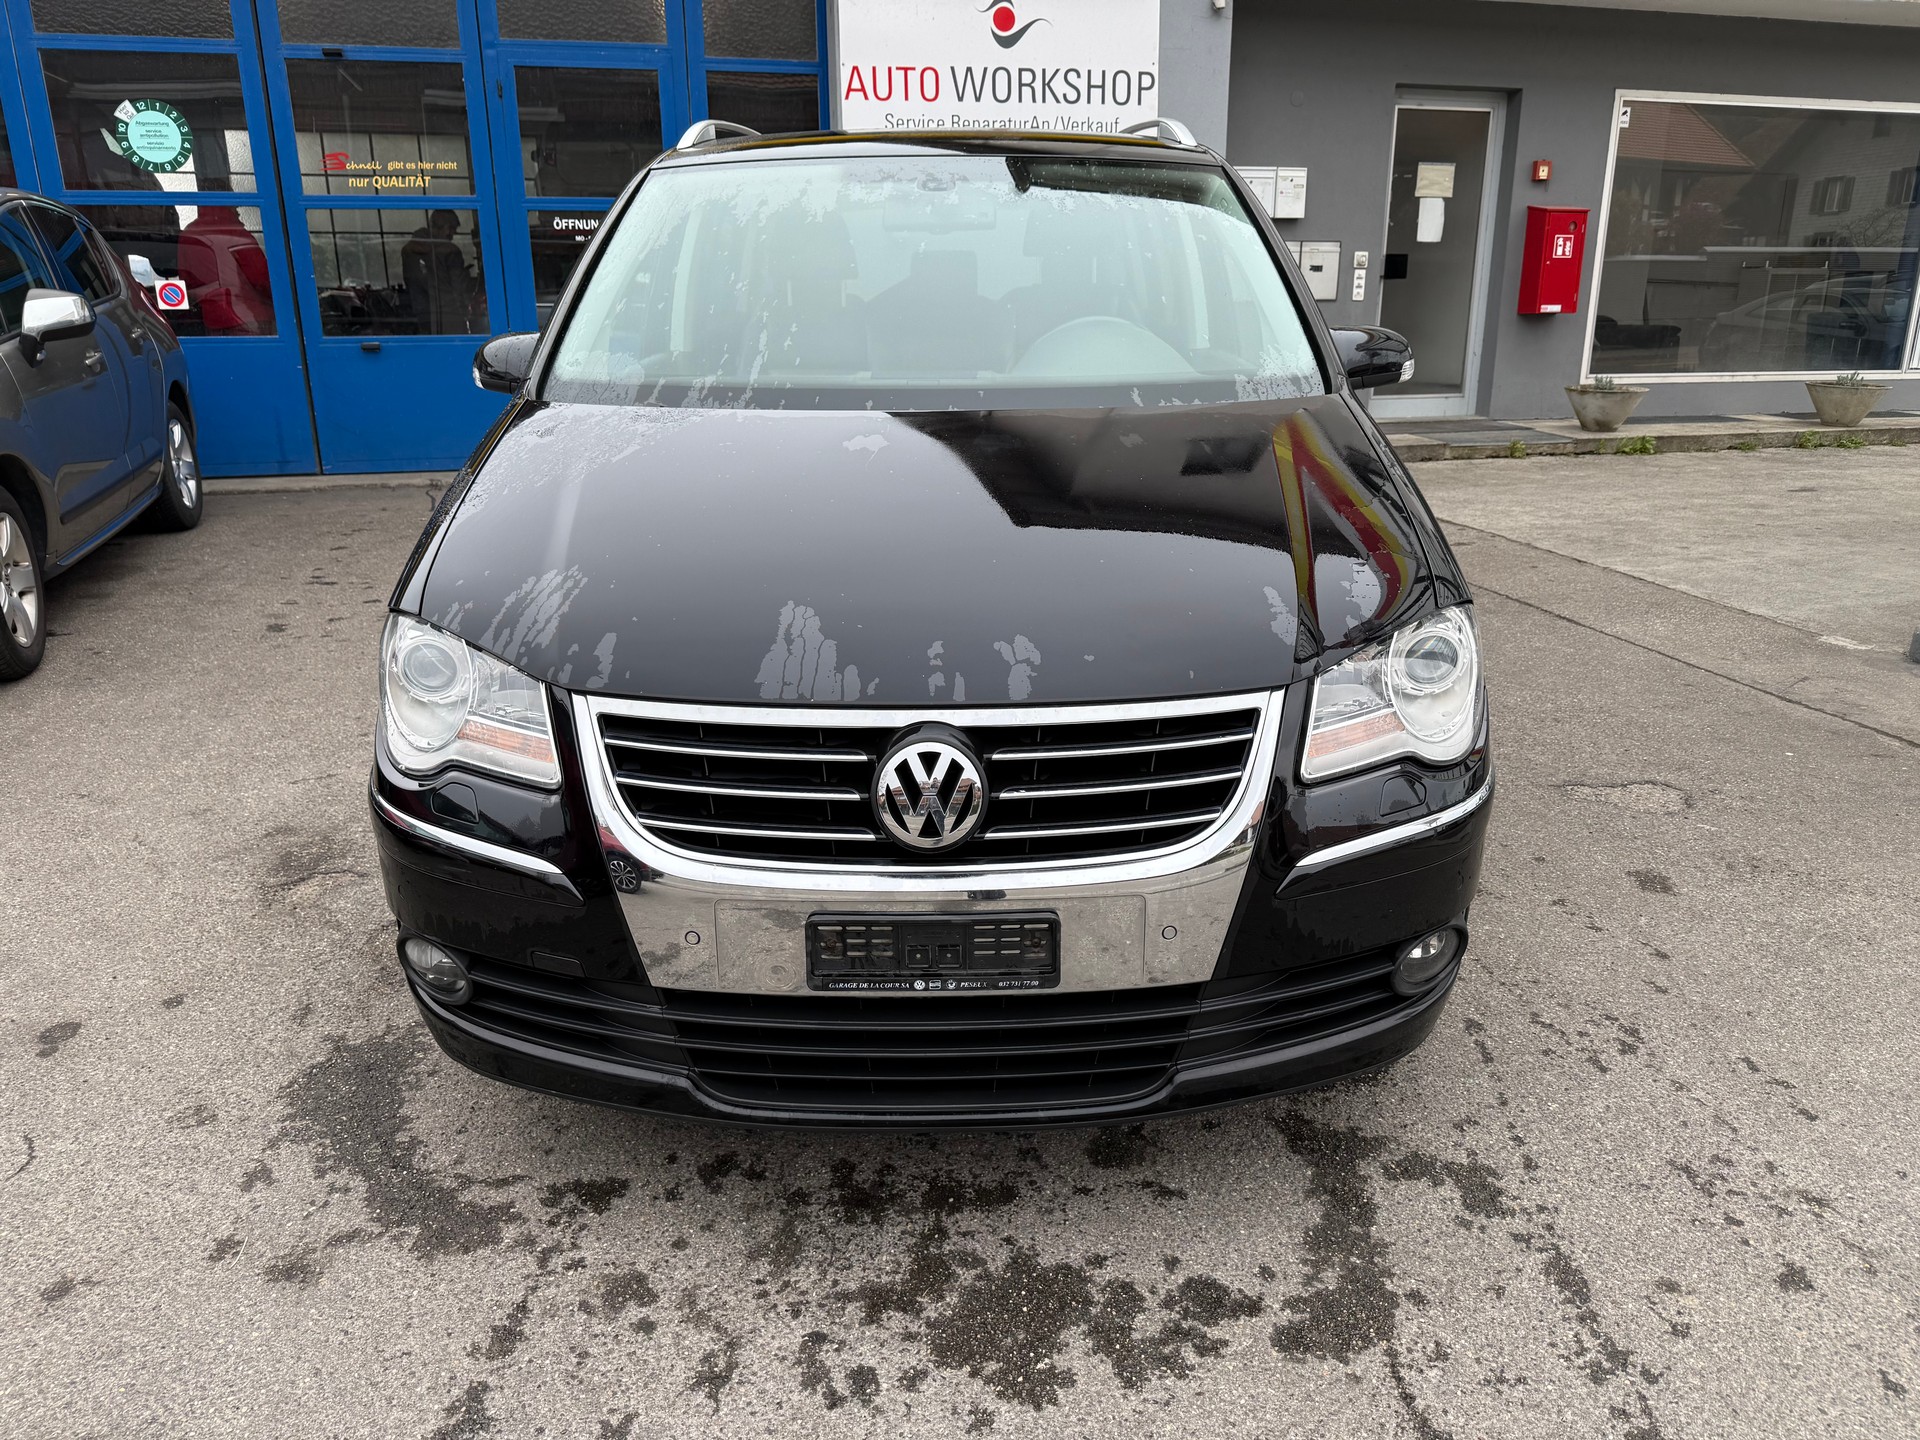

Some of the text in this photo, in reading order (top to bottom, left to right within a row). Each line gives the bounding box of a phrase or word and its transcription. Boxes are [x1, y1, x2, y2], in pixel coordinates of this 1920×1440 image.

[844, 65, 1155, 106] AUTO WORKSHOP
[136, 101, 147, 110] 12
[155, 102, 160, 110] 1
[169, 111, 177, 119] 2
[885, 113, 945, 128] Service
[118, 123, 126, 132] 10
[177, 155, 185, 163] 5
[148, 163, 154, 171] 7
[164, 163, 171, 171] 6
[387, 160, 404, 171] gibt
[405, 161, 416, 170] es
[418, 161, 434, 170] hier
[436, 161, 457, 170] nicht
[348, 173, 431, 188] nur QUALITÄT
[877, 741, 982, 848] VW
